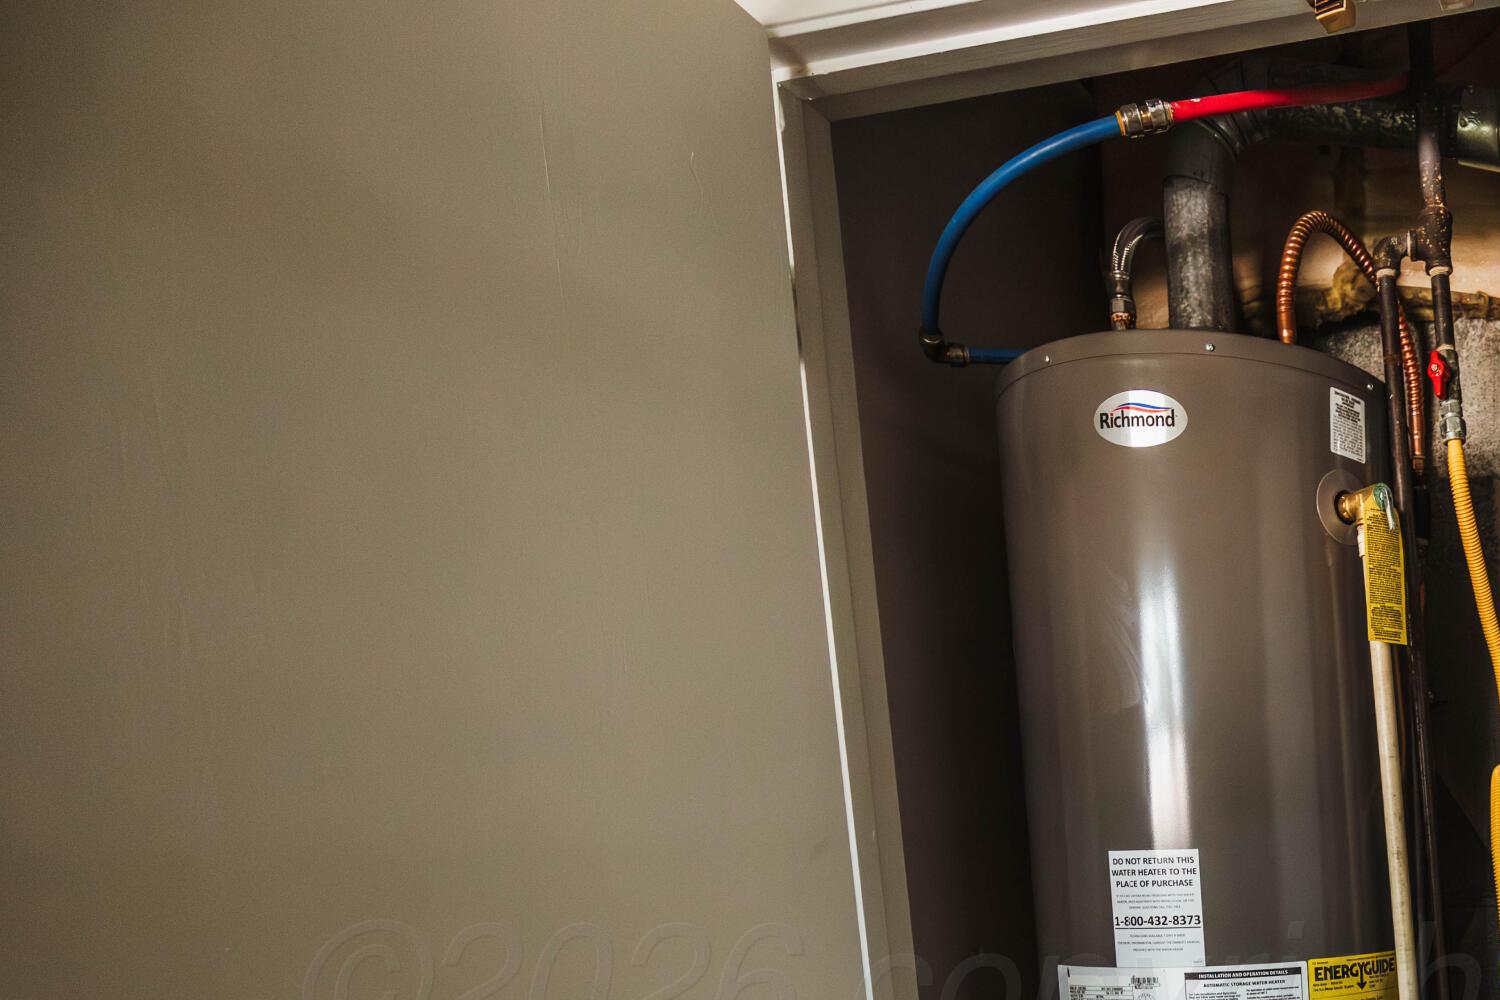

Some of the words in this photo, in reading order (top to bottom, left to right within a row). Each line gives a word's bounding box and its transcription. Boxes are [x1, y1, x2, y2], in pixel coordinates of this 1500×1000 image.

[1100, 409, 1175, 429] Richmond
[1152, 879, 1193, 887] PURCHASE
[1115, 915, 1201, 926] 1-800-432-8373
[1314, 957, 1396, 982] ENERGYGUIDE
